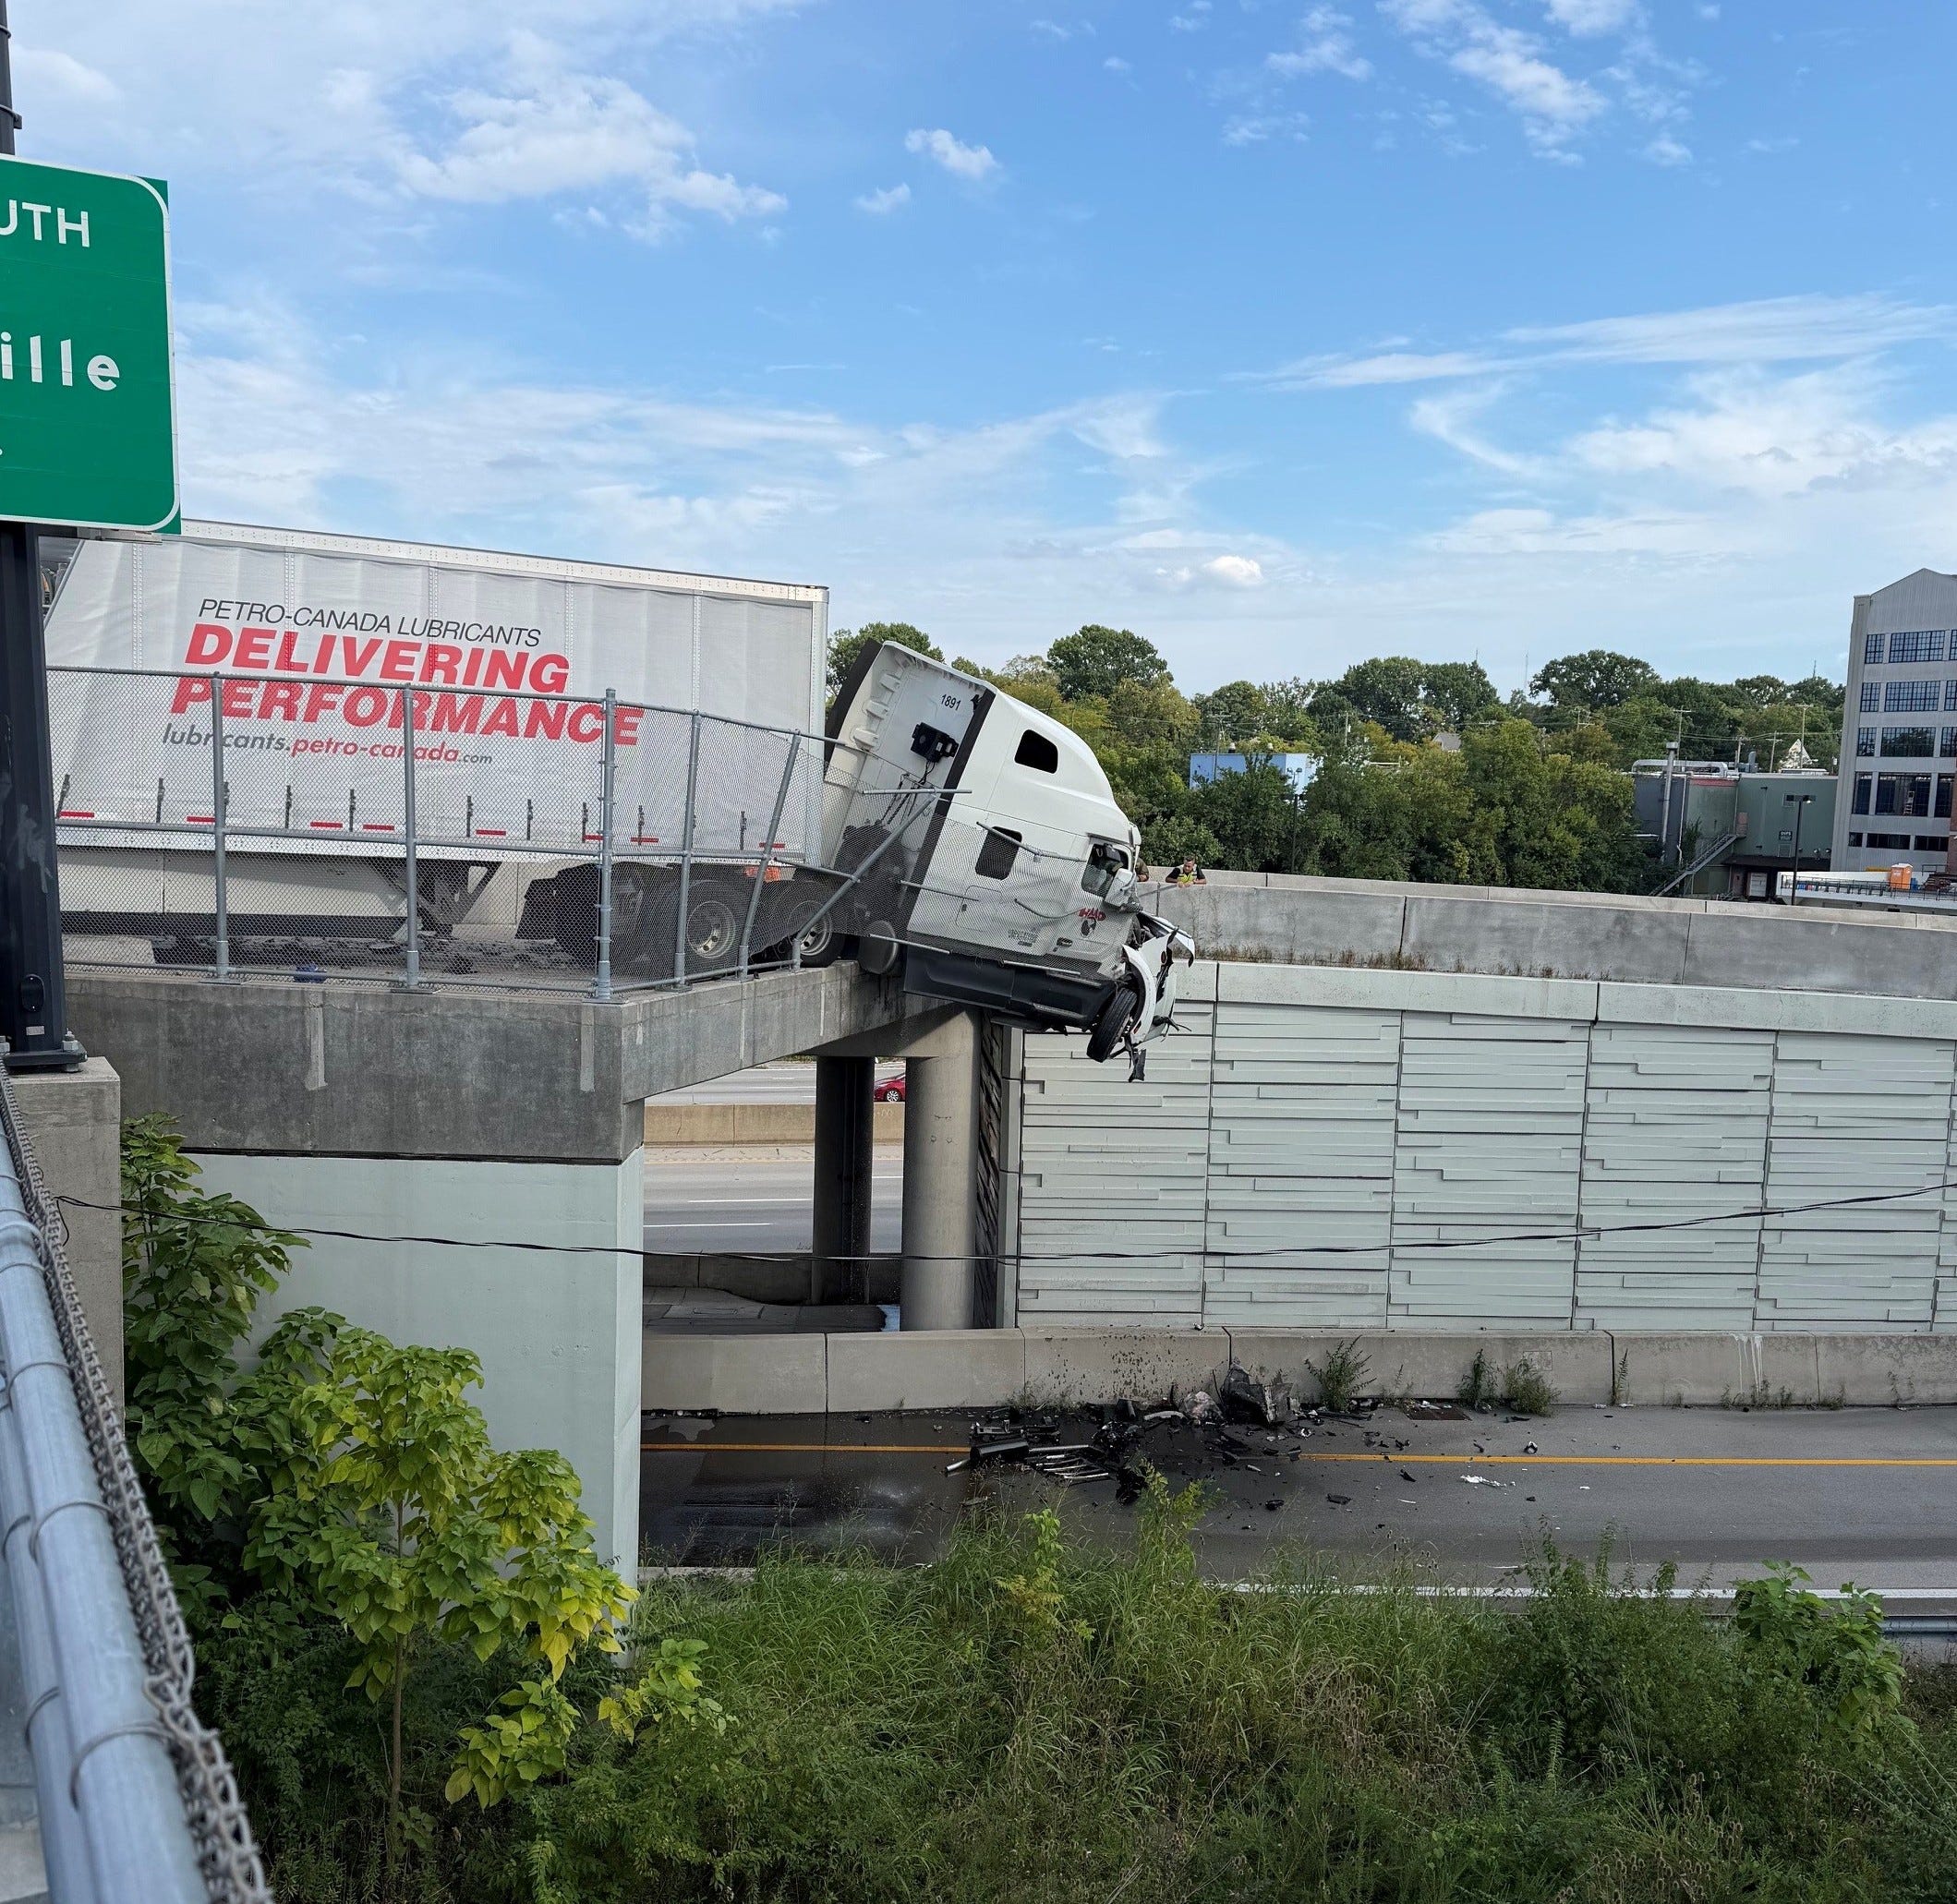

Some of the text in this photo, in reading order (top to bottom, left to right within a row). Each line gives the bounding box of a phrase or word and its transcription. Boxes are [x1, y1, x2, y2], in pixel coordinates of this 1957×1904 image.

[199, 598, 541, 647] PETRO-CANADA LUBRICANTS
[185, 623, 569, 693] DELIVERING
[170, 677, 645, 746] PERFORMANCE
[941, 693, 961, 711] 1891
